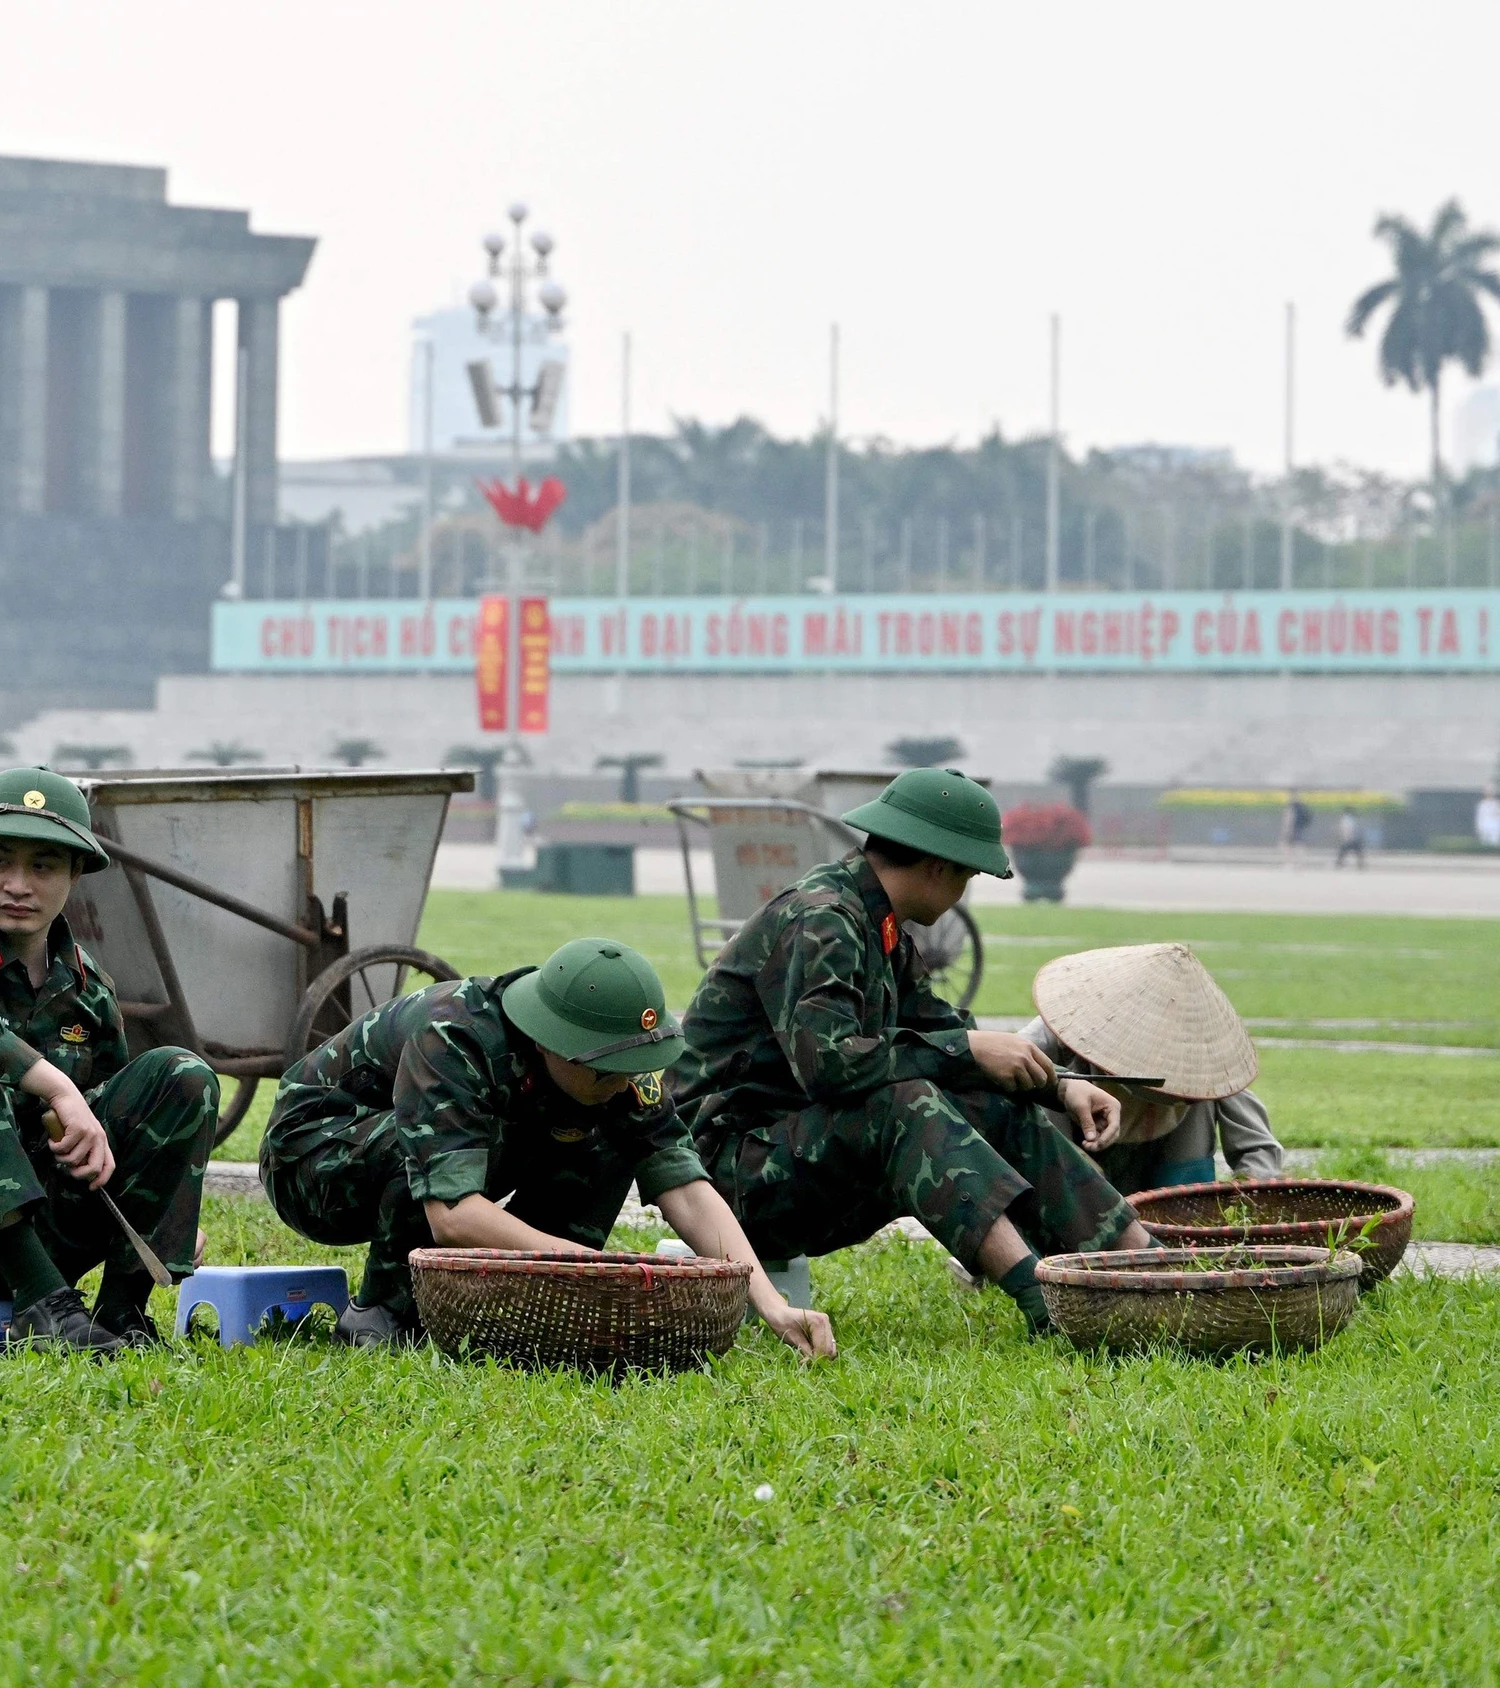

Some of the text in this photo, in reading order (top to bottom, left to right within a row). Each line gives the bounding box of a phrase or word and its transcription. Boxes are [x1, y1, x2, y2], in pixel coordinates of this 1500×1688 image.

[261, 600, 315, 658] CHỦ
[328, 615, 387, 665] TỊCH
[400, 598, 435, 658] HỒ
[705, 598, 790, 657] SỐNG
[802, 603, 863, 657] MÃI
[876, 610, 983, 657] TRONG
[997, 602, 1043, 664] SỰ
[1054, 597, 1180, 663] NGHIỆP
[1193, 590, 1260, 656] CỦA
[1278, 598, 1400, 655] CHÚNG
[1416, 607, 1460, 655] TA
